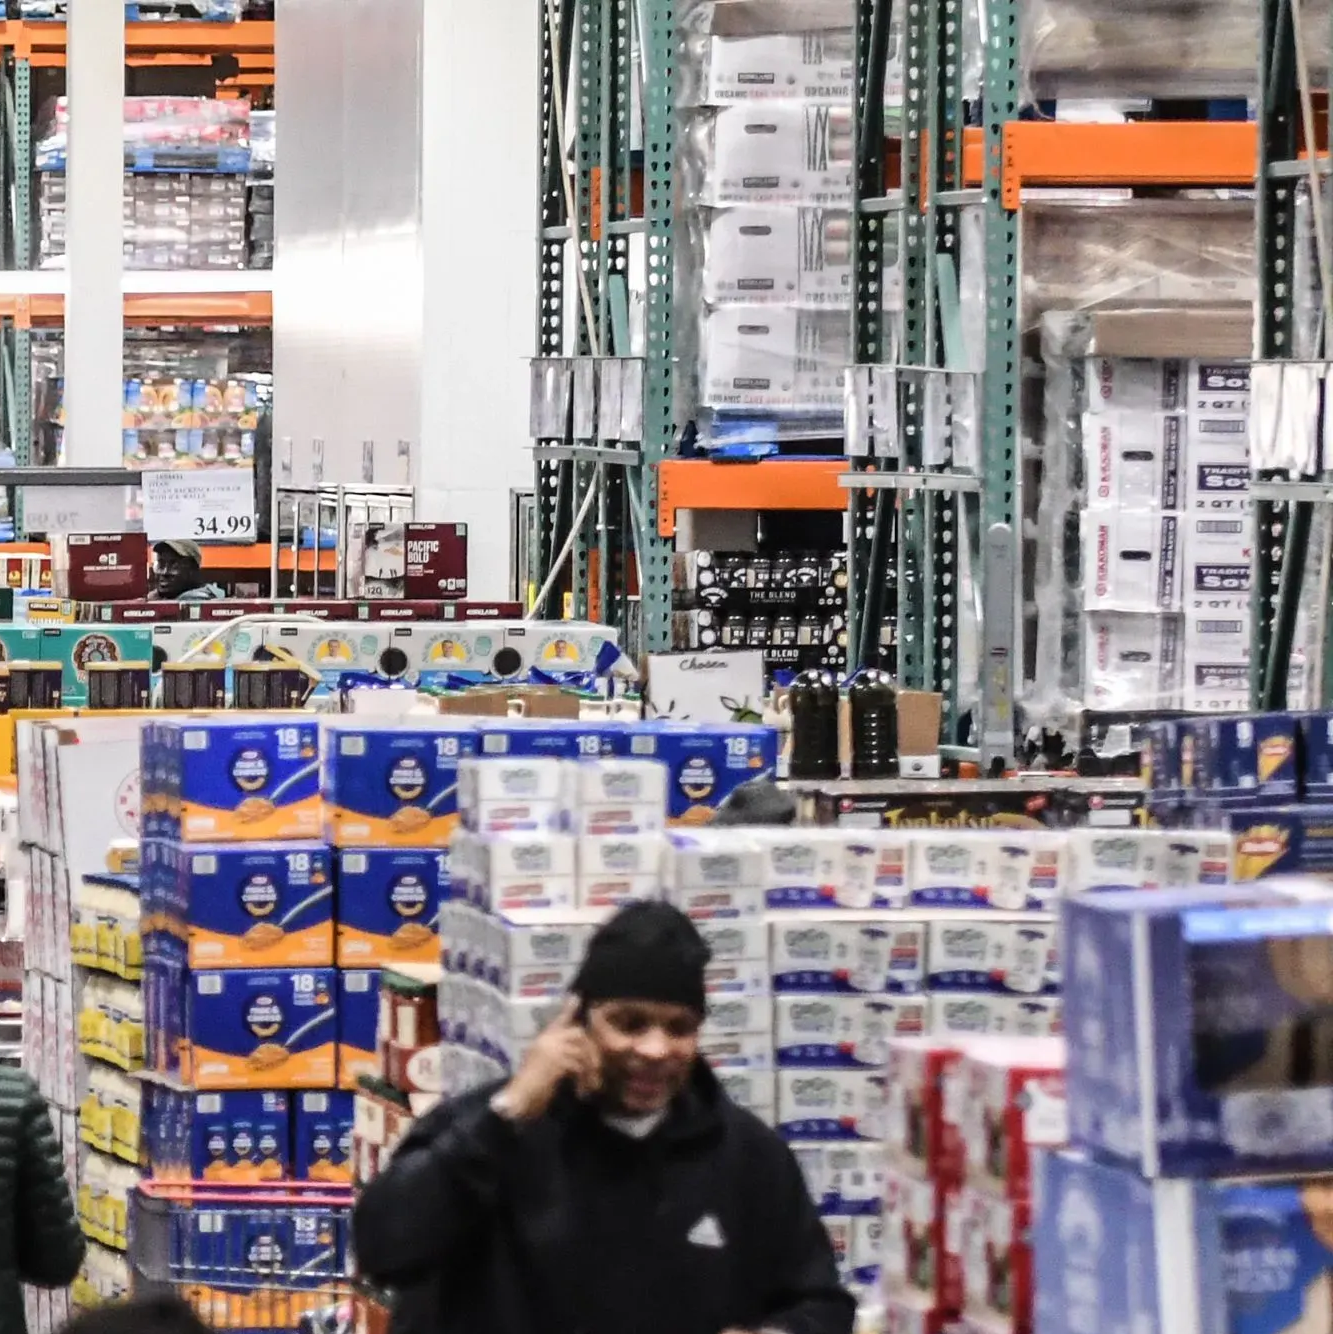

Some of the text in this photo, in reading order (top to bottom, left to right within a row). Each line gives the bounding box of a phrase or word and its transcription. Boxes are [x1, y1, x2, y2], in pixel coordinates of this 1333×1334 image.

[1213, 400, 1234, 409] QT
[1211, 500, 1232, 508] QT
[194, 516, 251, 535] 34.99
[407, 540, 439, 553] PACIFIC
[407, 551, 430, 564] BOLD
[749, 591, 797, 599] THE BLEND
[771, 649, 799, 658] BLEND
[679, 658, 729, 670] Chosen
[275, 728, 299, 746] 18
[576, 736, 599, 753] 18
[434, 738, 459, 755] 18
[724, 738, 748, 755] 18
[285, 853, 310, 871] 18
[290, 974, 314, 992] 18
